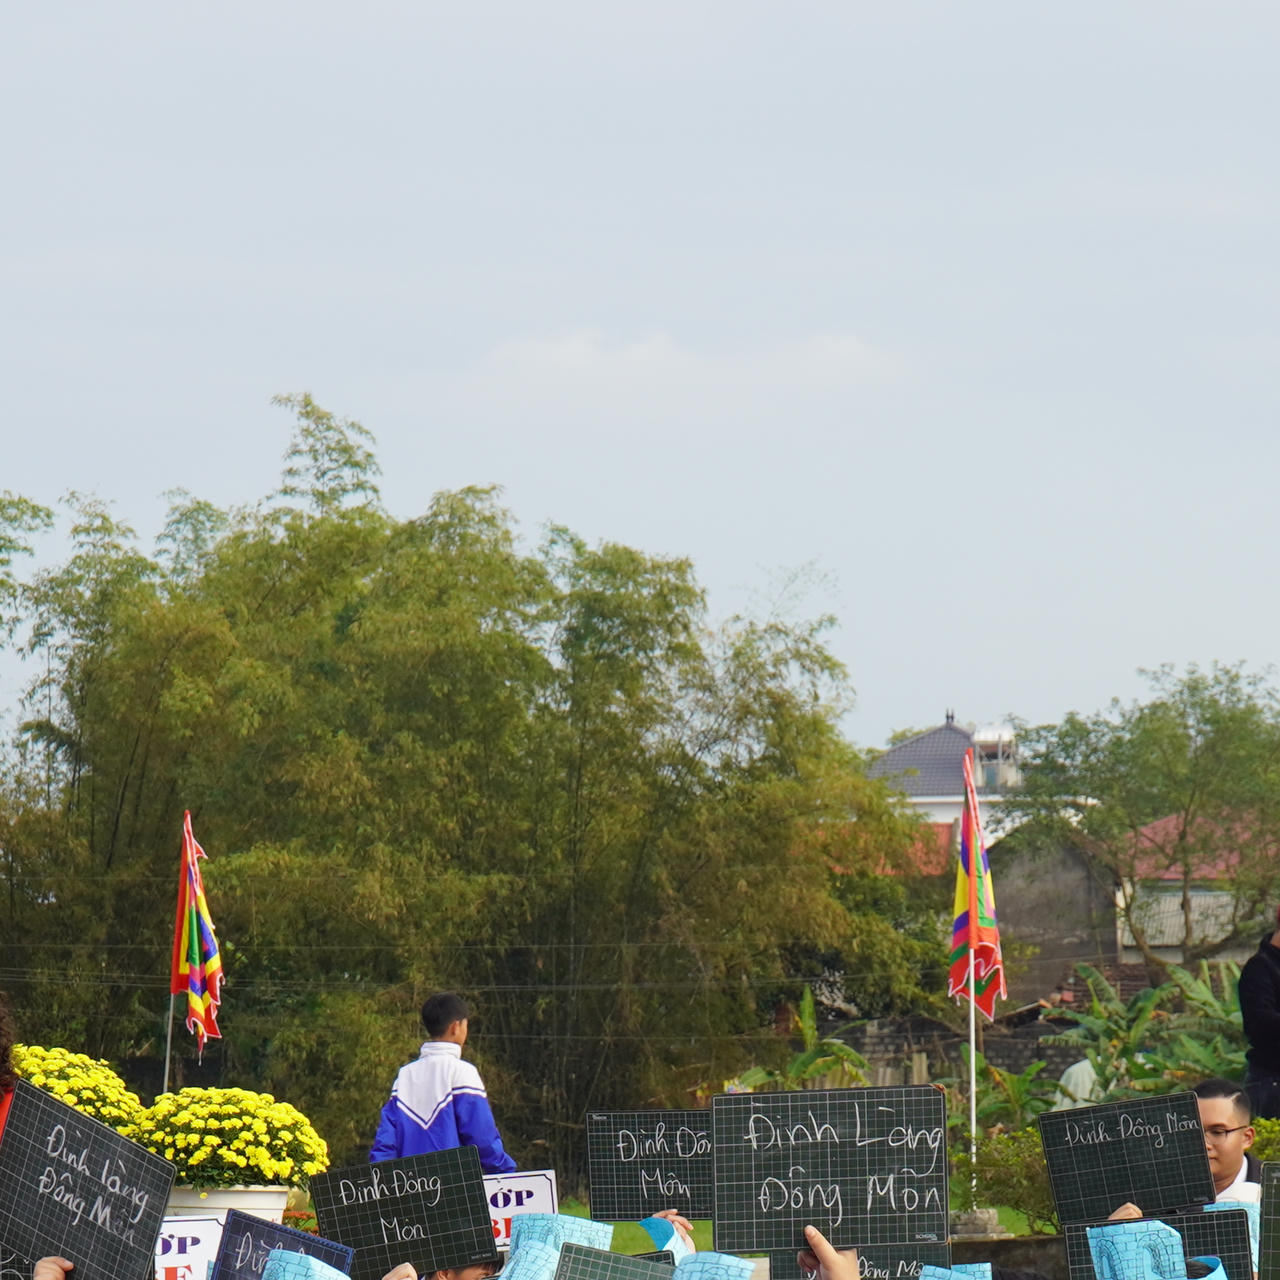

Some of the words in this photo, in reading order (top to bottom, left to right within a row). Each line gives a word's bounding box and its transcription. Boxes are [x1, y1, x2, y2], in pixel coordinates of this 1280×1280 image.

[617, 1121, 670, 1162] Đình
[675, 1126, 711, 1158] Đôn
[1116, 1112, 1162, 1149] Đông
[46, 1124, 90, 1177] Đình
[100, 1158, 150, 1224] làng
[339, 1167, 389, 1206] Đình
[391, 1168, 441, 1207] Đông
[641, 1167, 691, 1200] Môn
[38, 1166, 87, 1227] Đông
[490, 1187, 535, 1209] ỚP
[758, 1165, 843, 1228] Đông
[157, 1232, 201, 1256] ỚP
[380, 1215, 428, 1244] Môn
